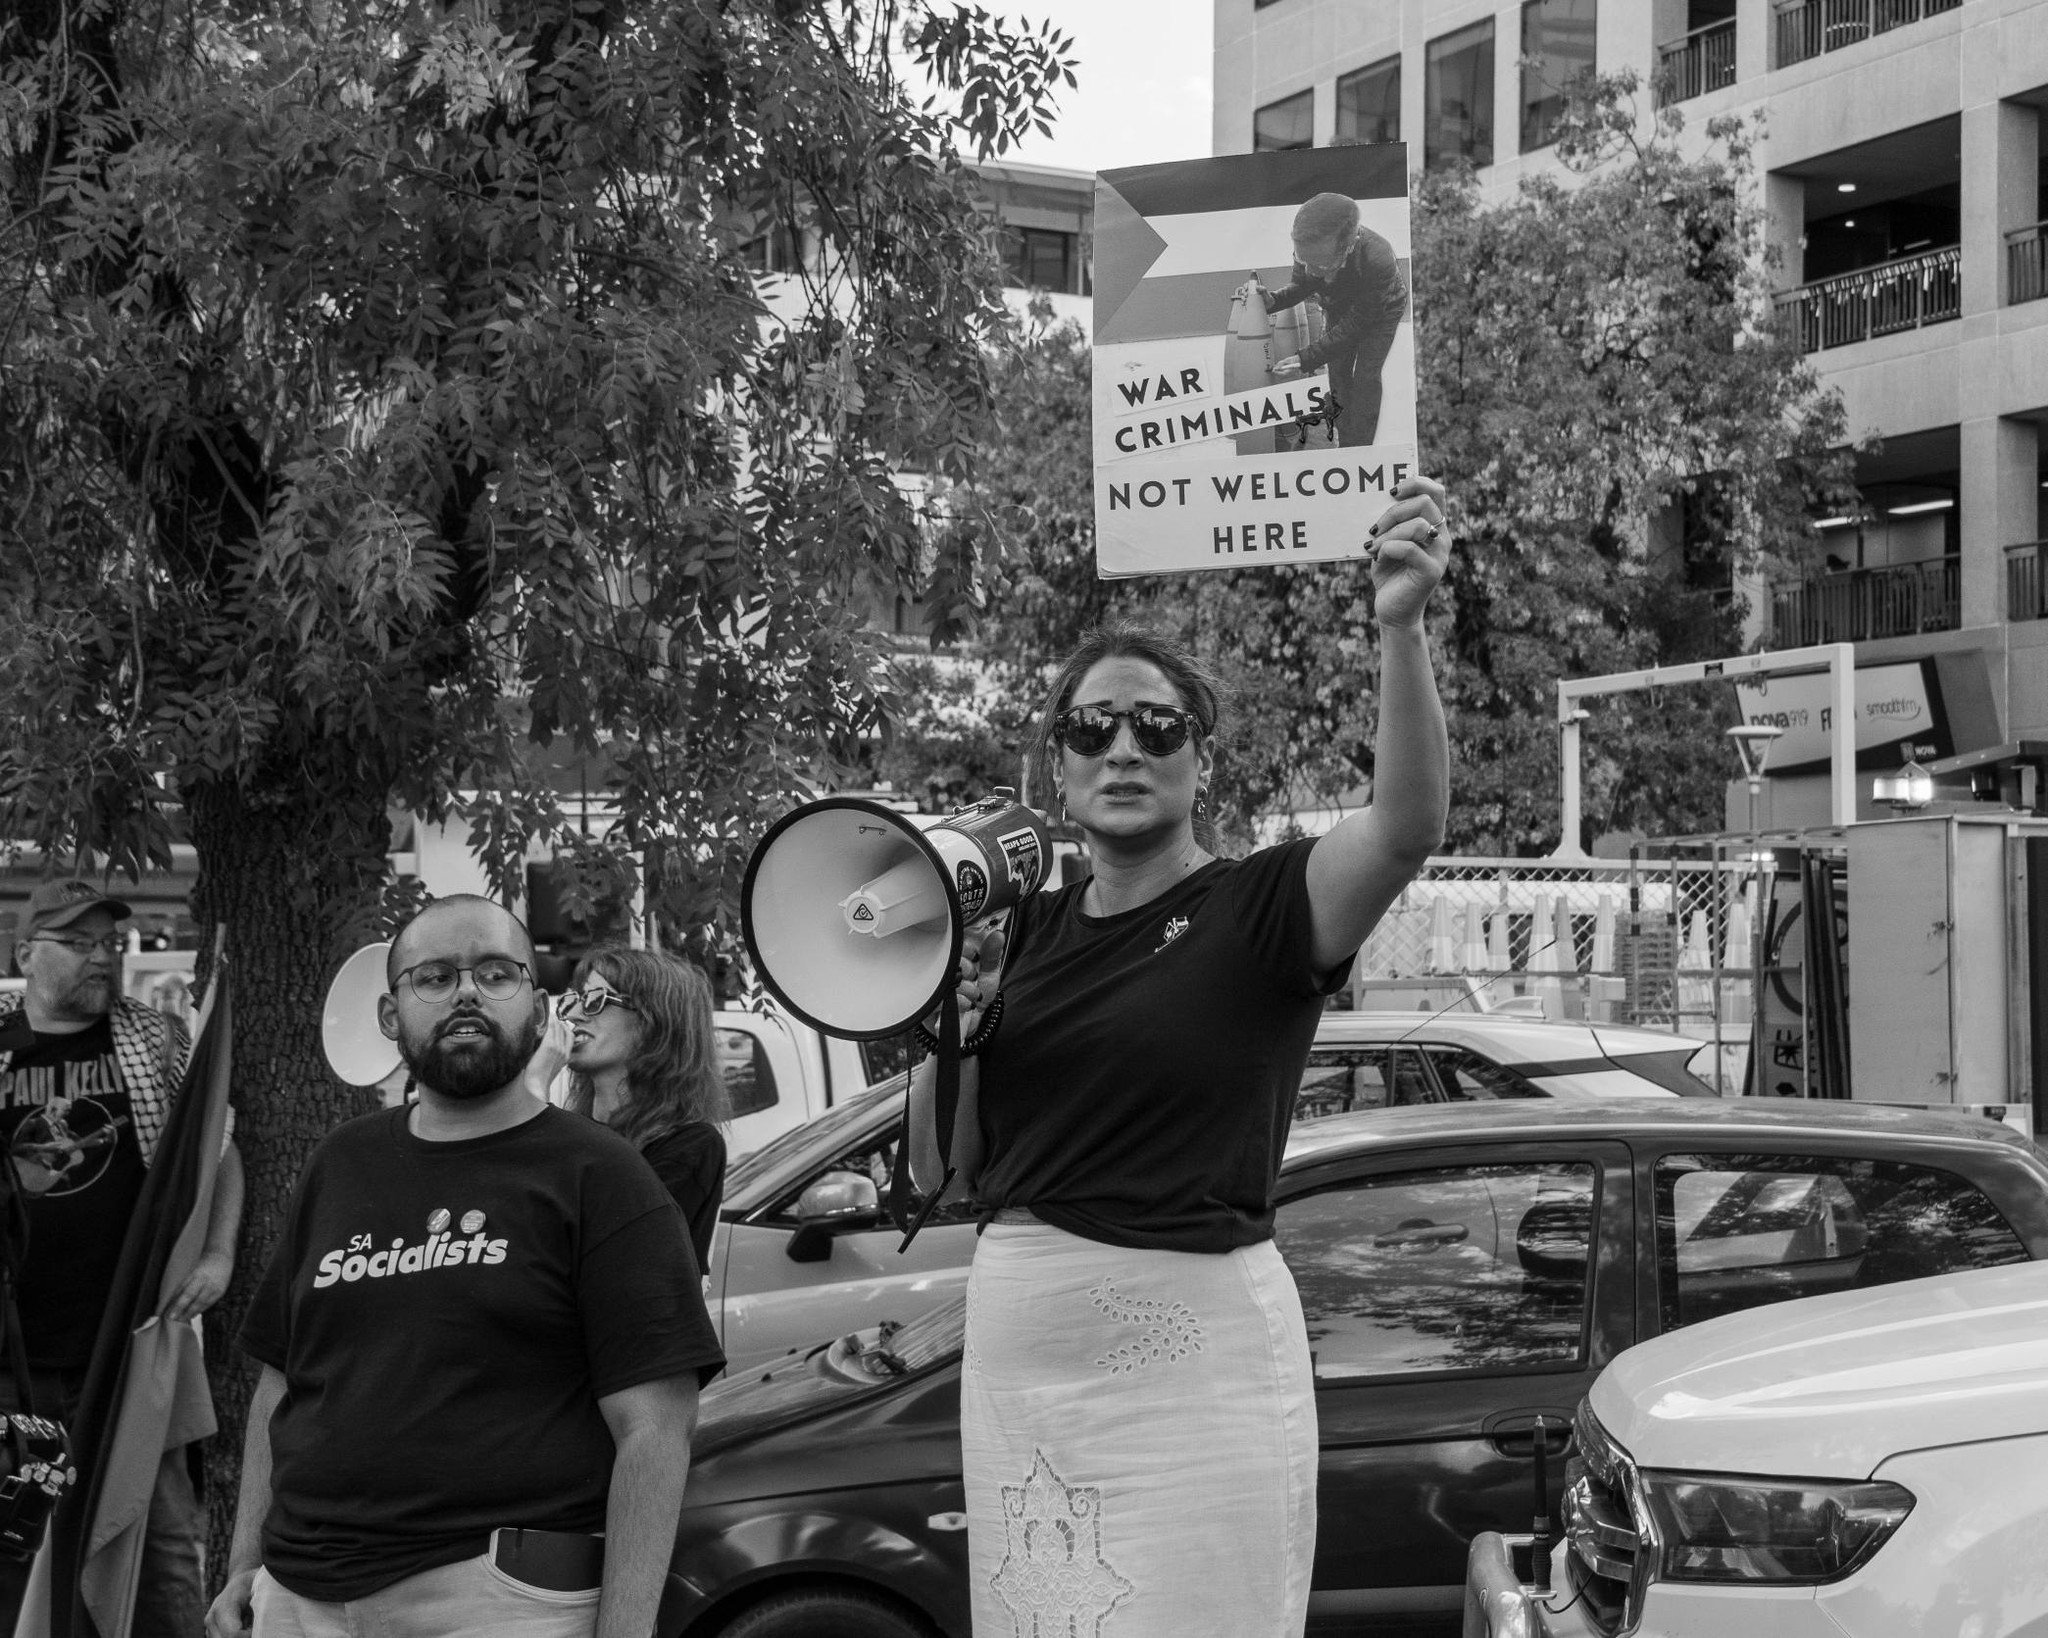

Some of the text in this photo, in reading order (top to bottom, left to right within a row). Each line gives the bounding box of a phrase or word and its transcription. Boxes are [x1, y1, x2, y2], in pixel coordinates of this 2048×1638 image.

[1117, 367, 1204, 408] WAR
[1114, 386, 1326, 453] CRIMINALS
[1109, 463, 1408, 511] NOT WELCOME
[1213, 521, 1308, 554] HERE
[313, 1231, 509, 1288] Socialists
[347, 1233, 372, 1252] SA
